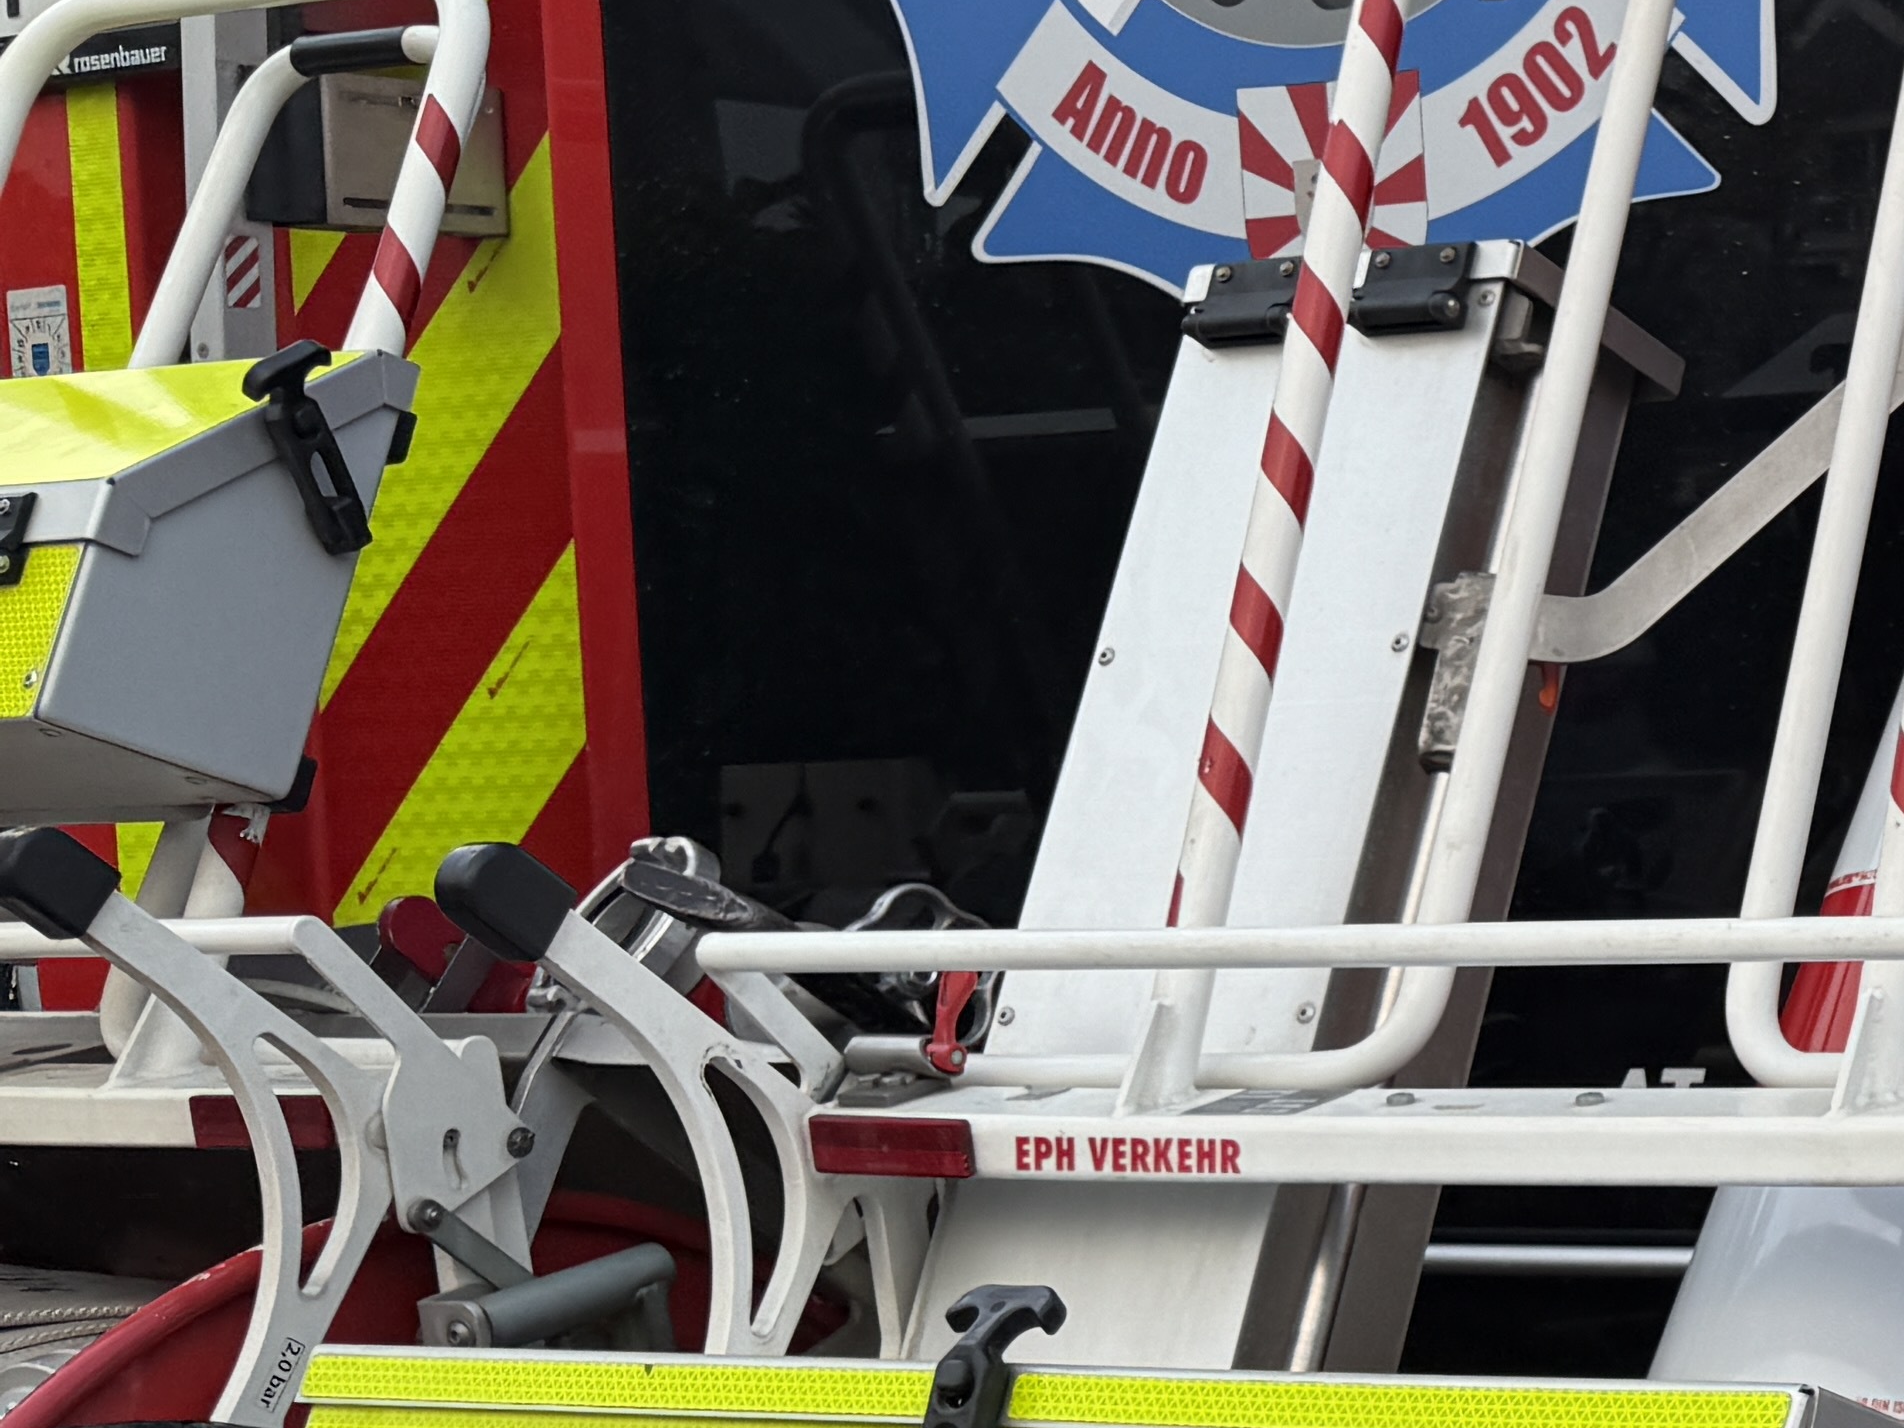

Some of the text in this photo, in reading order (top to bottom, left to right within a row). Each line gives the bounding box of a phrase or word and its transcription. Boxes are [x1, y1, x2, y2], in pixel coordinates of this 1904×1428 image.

[74, 45, 167, 73] rosenbauer
[1457, 5, 1617, 167] 1902
[1051, 60, 1208, 205] Anno
[1015, 1136, 1242, 1174] EPH VERKEHR
[261, 1342, 301, 1408] 2,0 bar
